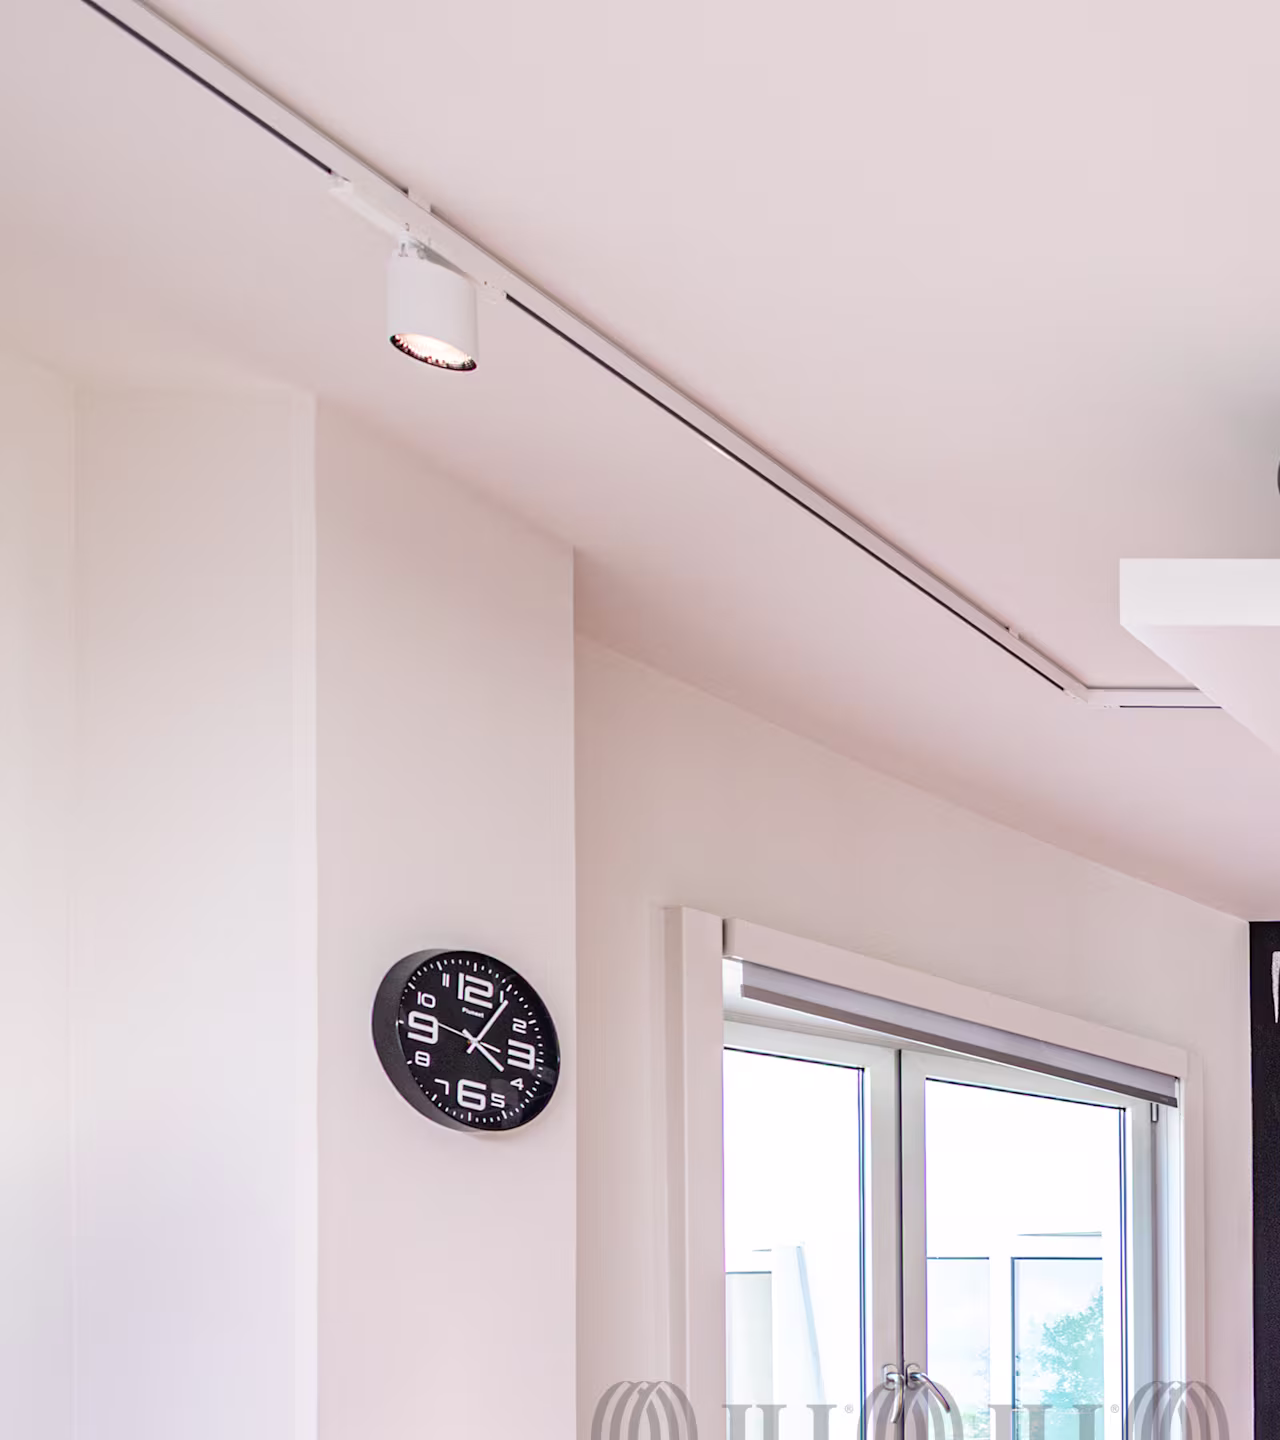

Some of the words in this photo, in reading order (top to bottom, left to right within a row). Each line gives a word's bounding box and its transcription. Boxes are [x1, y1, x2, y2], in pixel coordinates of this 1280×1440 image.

[457, 972, 493, 1009] 12
[416, 991, 436, 1008] 10
[407, 1010, 439, 1045] 9
[512, 1018, 528, 1034] 2
[414, 1051, 430, 1067] 8
[507, 1038, 536, 1070] 3
[434, 1078, 450, 1095] 7
[510, 1077, 524, 1091] 4
[457, 1078, 486, 1111] 6
[490, 1093, 506, 1109] 5
